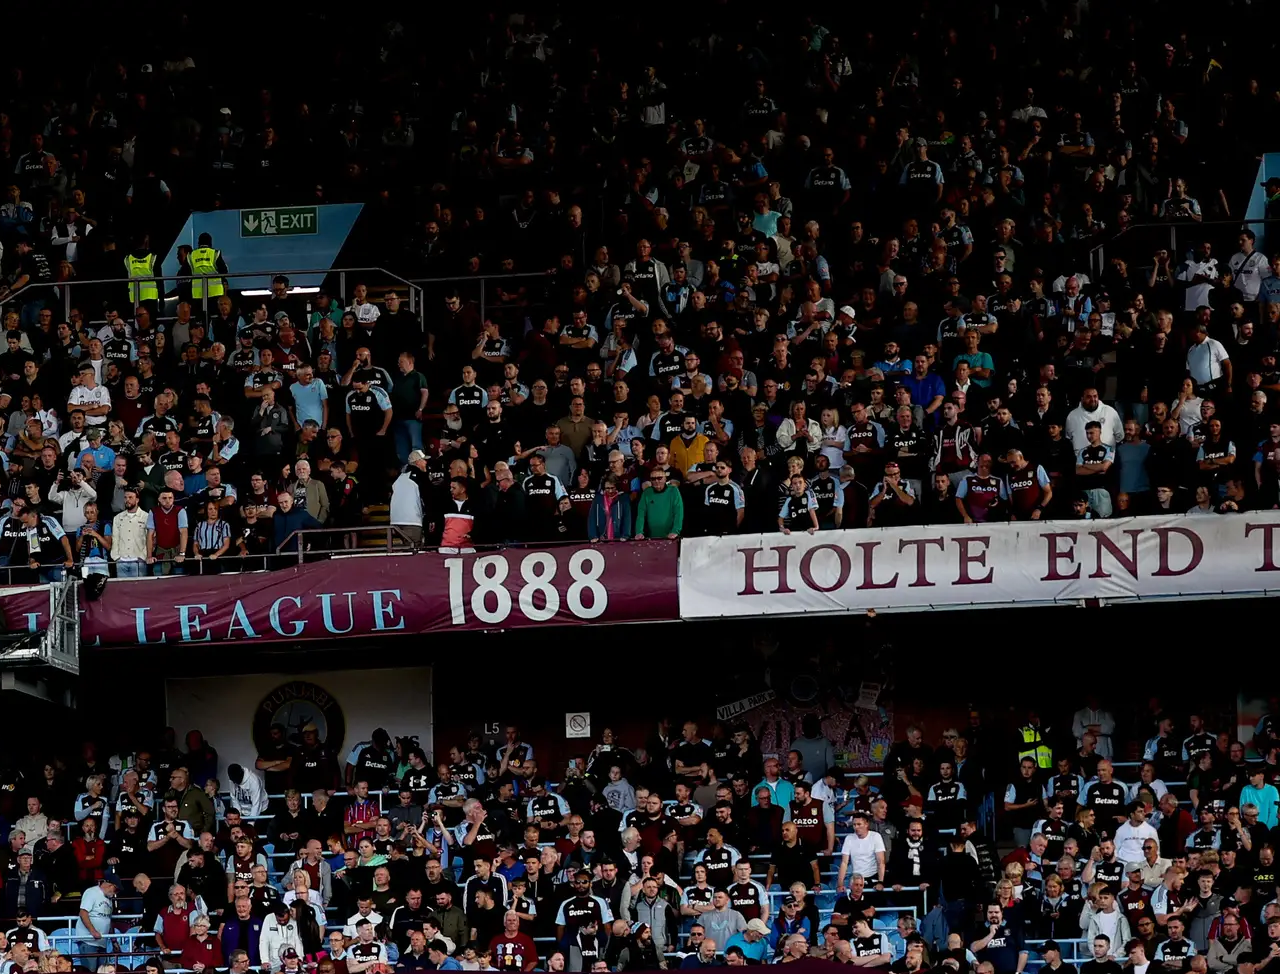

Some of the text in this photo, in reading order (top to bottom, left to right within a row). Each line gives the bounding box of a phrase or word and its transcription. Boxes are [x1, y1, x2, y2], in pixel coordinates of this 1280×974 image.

[279, 213, 314, 229] EXIT
[107, 351, 127, 359] Betano
[737, 536, 994, 596] HOLTE
[1040, 527, 1204, 581] END
[130, 588, 406, 646] LEAGUE
[442, 549, 609, 626] 1888
[262, 682, 333, 712] PUNJABI
[717, 702, 745, 720] VILLA
[485, 723, 499, 734] L5
[366, 760, 386, 769] Betano
